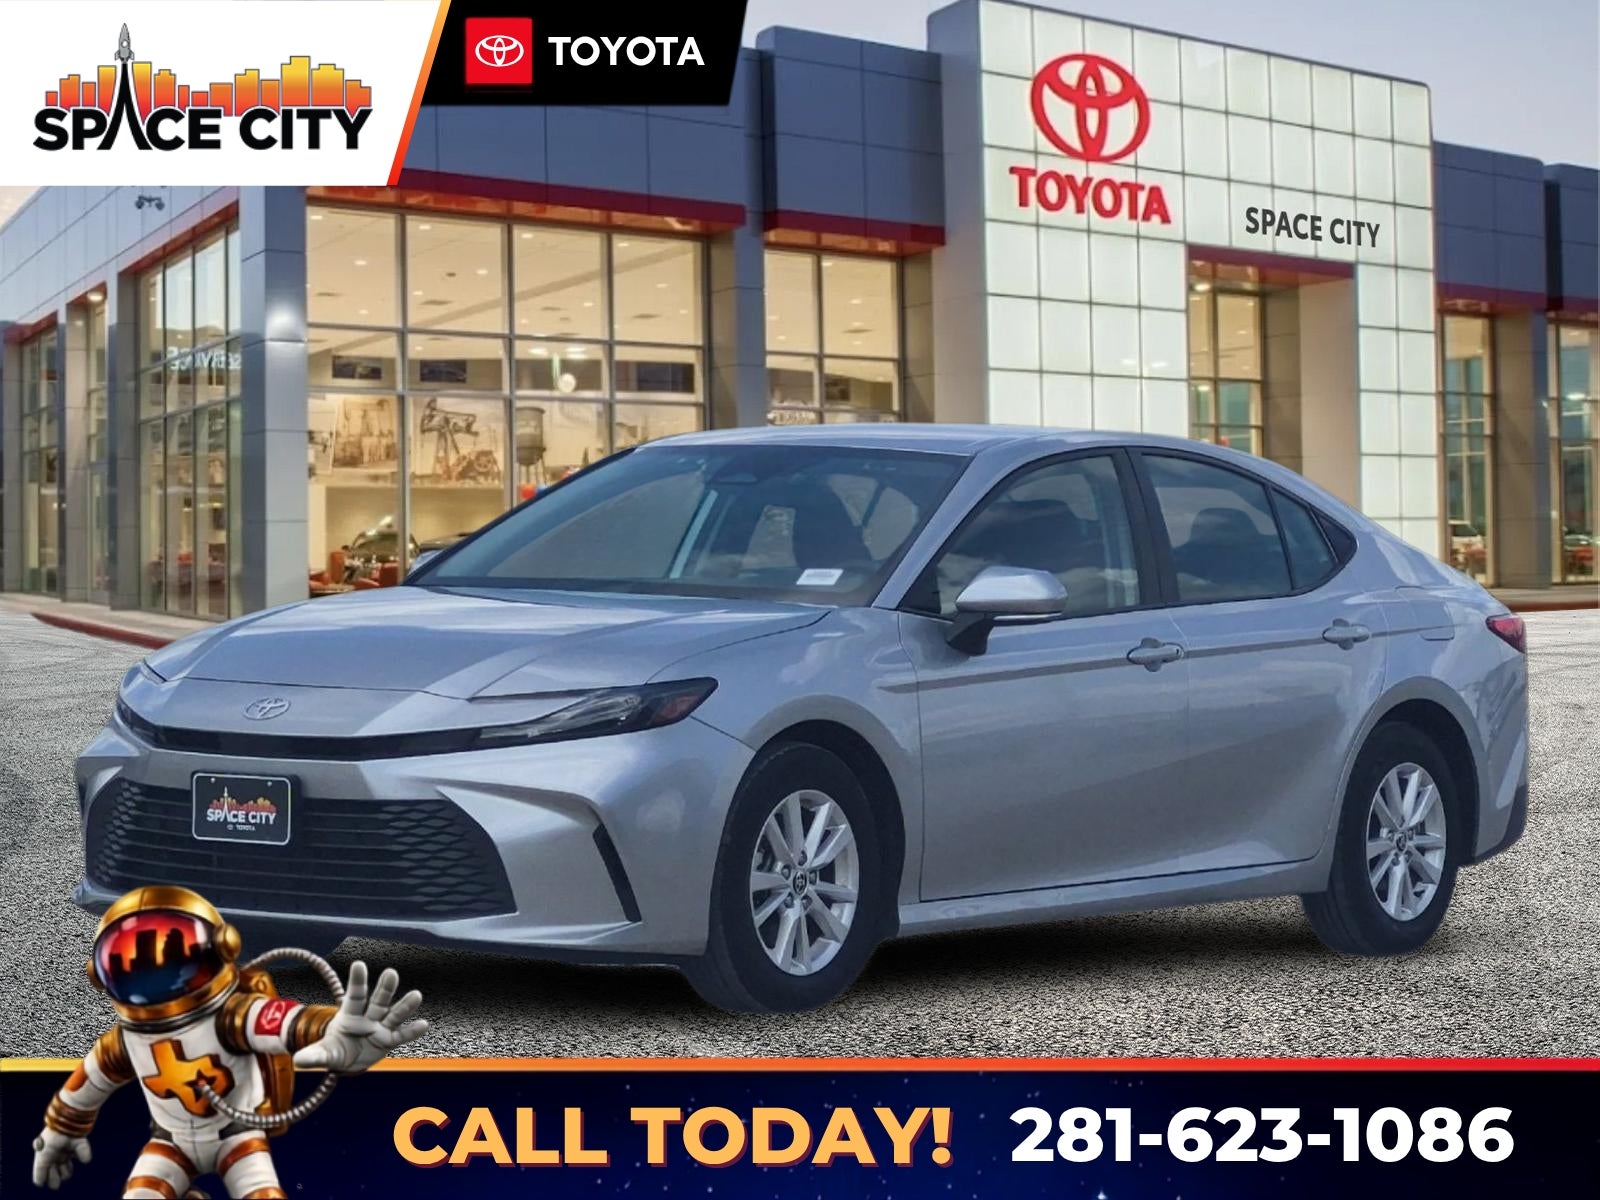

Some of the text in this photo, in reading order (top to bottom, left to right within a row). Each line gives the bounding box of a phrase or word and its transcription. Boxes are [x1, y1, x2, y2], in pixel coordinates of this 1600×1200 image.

[1009, 166, 1171, 224] TOYOTA
[1245, 206, 1380, 248] SPACE CITY
[206, 808, 277, 825] SPACE CITY
